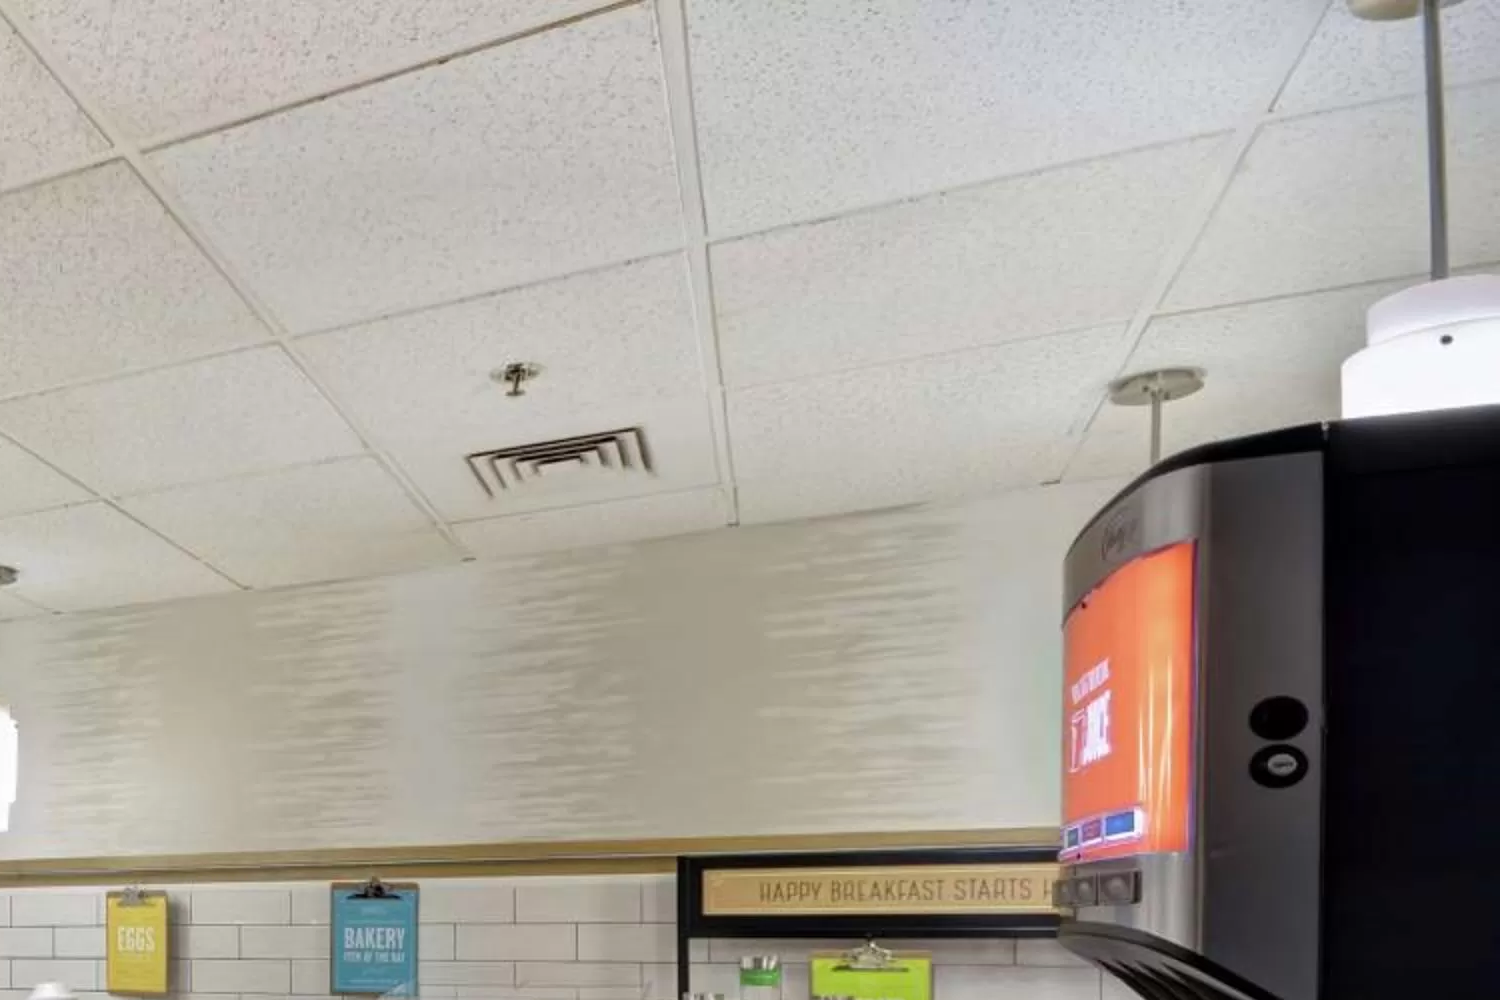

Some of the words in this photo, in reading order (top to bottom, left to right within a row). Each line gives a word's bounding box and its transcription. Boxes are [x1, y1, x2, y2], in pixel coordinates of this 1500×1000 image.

[759, 881, 822, 903] HAPPY
[830, 879, 945, 903] BREAKFAST
[953, 877, 1032, 901] STARTS
[117, 926, 155, 952] EGGS
[344, 927, 405, 949] BAKERY
